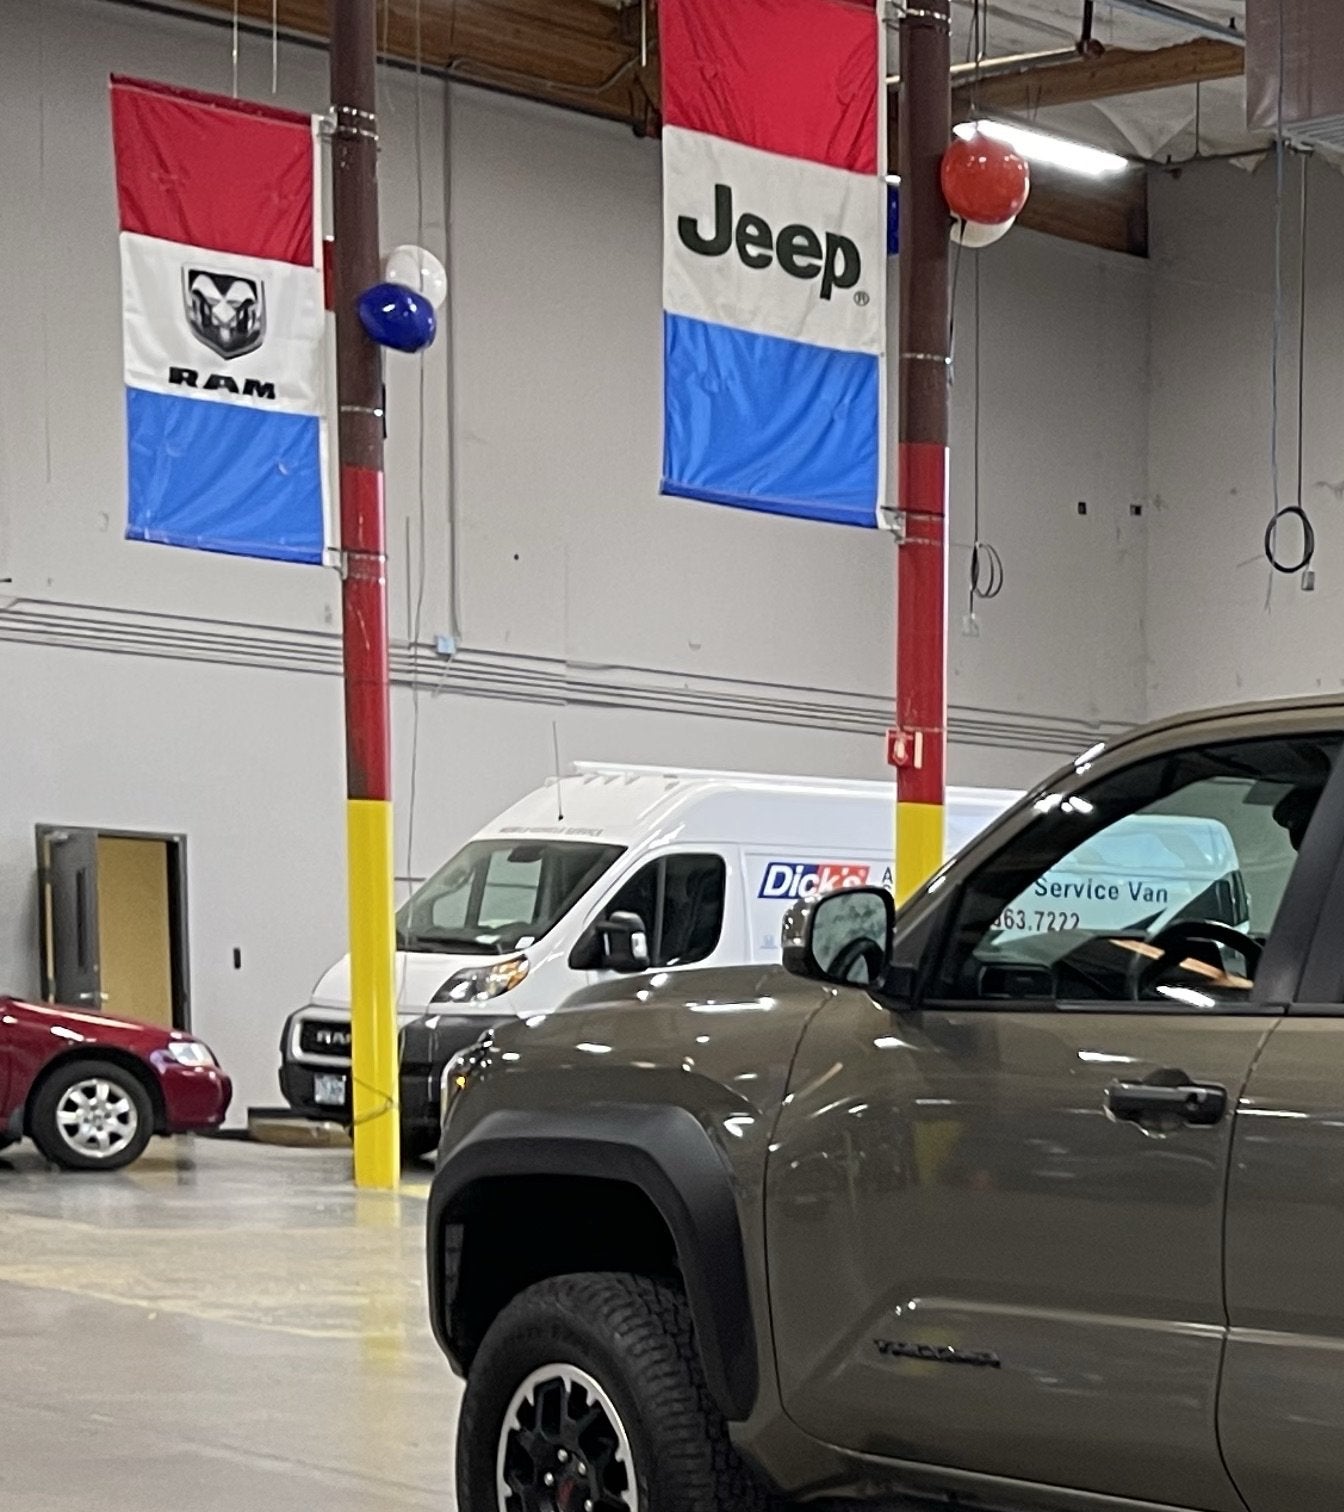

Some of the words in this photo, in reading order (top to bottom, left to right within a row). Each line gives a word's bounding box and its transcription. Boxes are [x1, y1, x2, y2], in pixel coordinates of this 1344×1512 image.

[678, 184, 862, 300] Jeep
[169, 366, 277, 400] RAM
[1034, 878, 1120, 900] Service
[1128, 881, 1168, 903] Van
[316, 1030, 352, 1044] RA
